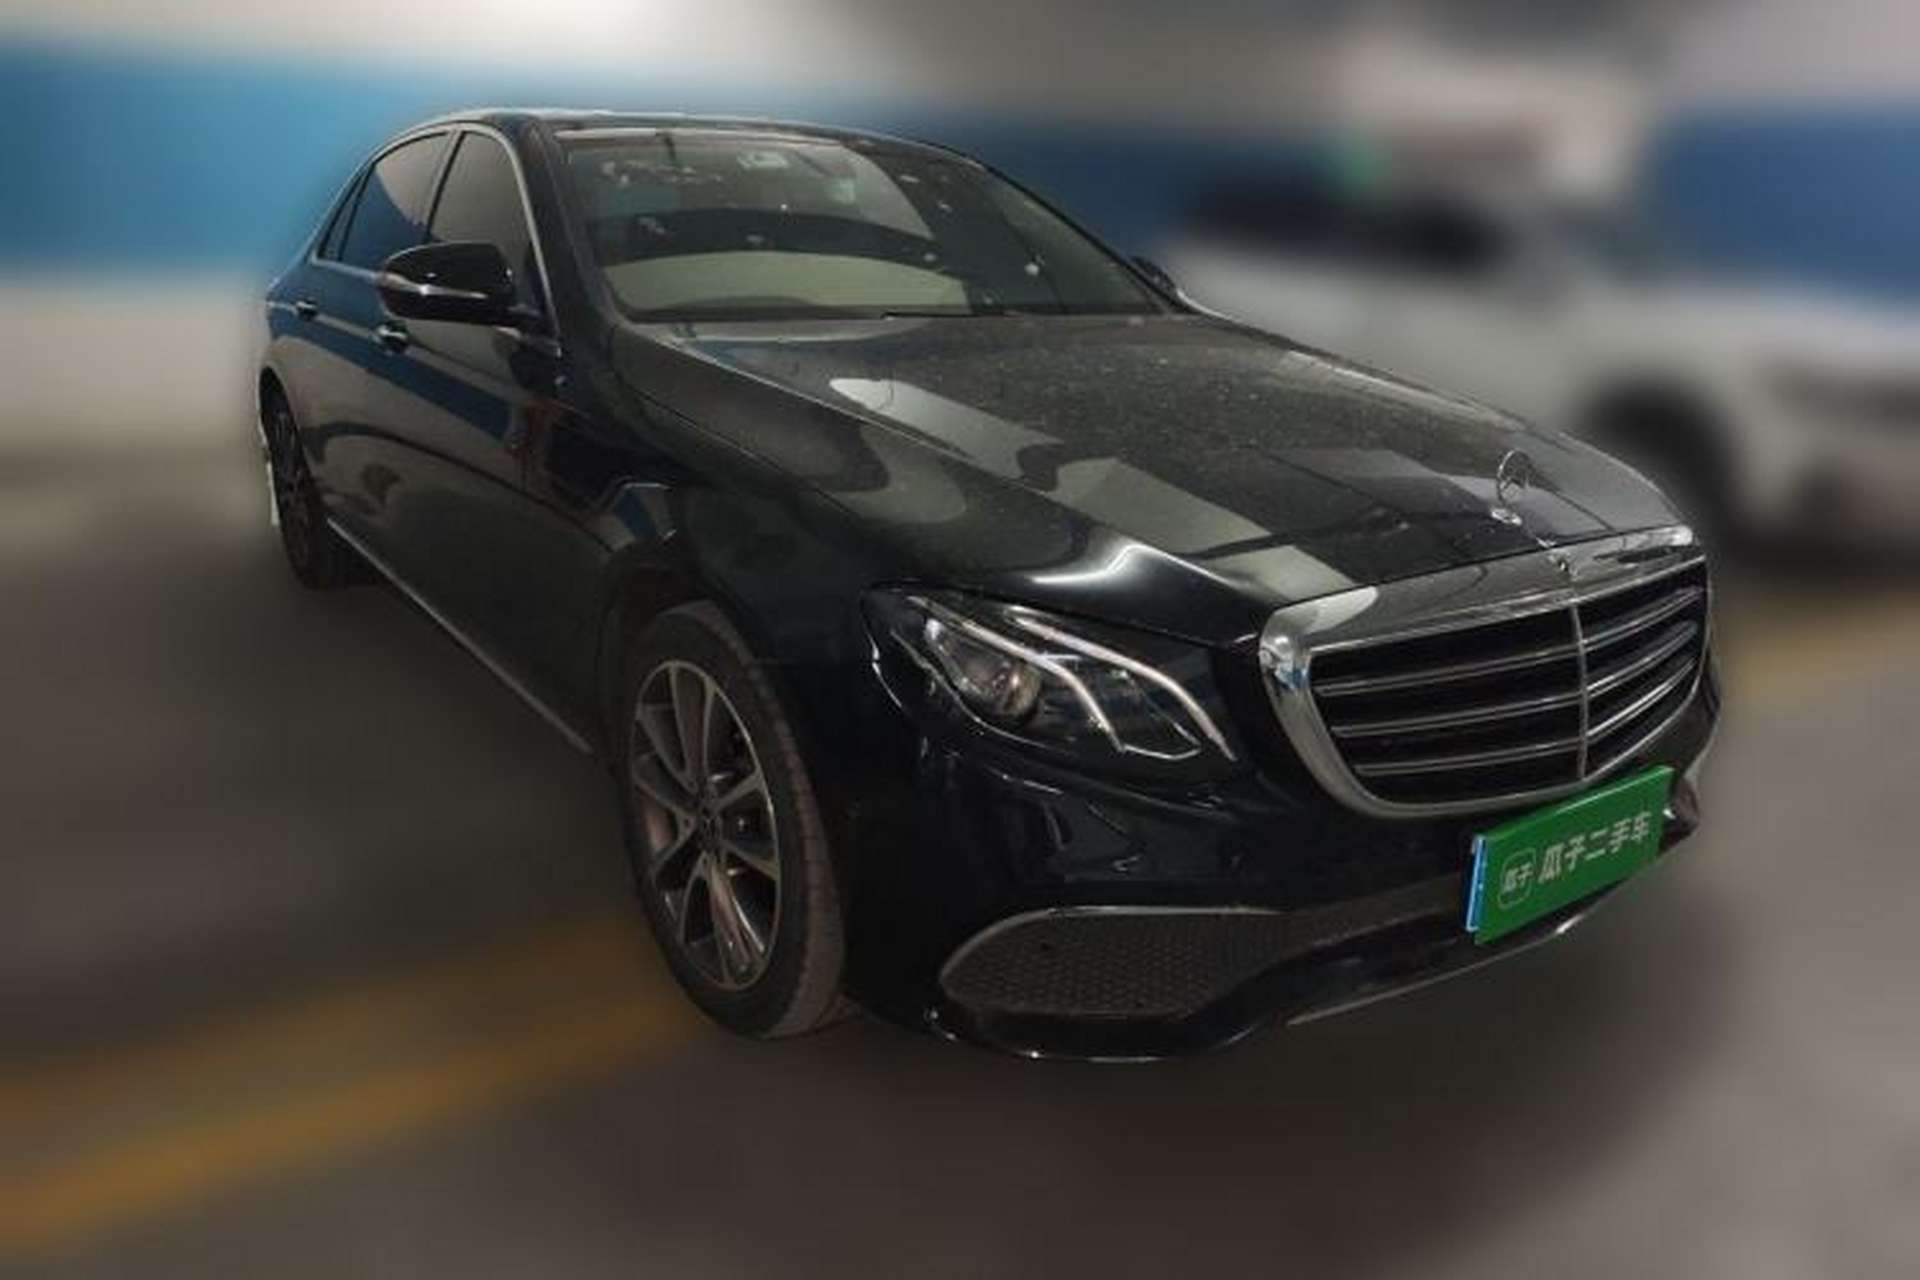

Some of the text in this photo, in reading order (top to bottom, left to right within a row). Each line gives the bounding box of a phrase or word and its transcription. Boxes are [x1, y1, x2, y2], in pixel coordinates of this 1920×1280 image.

[1539, 811, 1651, 883] 瓜子二手车
